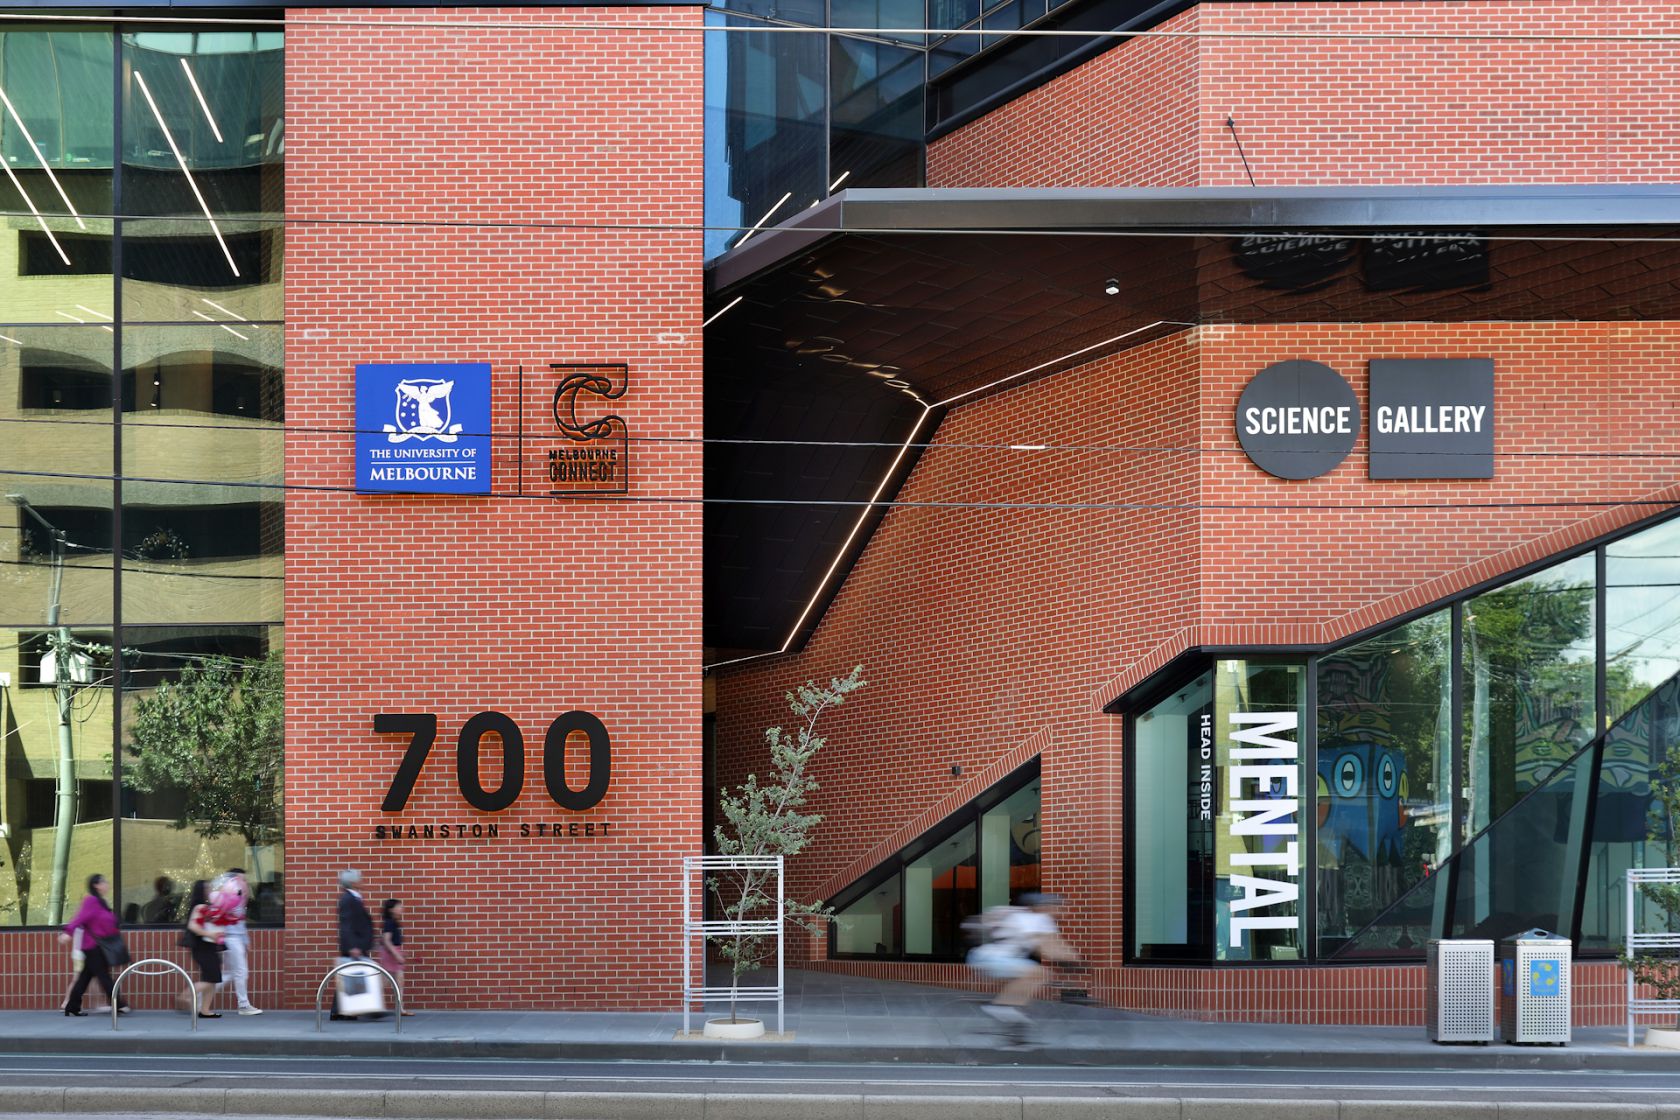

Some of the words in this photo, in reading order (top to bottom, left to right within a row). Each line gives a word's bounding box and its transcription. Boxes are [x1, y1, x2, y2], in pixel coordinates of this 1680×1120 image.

[1245, 406, 1352, 435] SCIENCE
[1377, 405, 1486, 434] GALLERY
[369, 449, 391, 459] THE
[394, 448, 459, 459] UNIVERSITY
[461, 448, 477, 459] OF
[549, 449, 617, 460] MELBOURNE
[369, 467, 477, 481] MELBOURNE
[549, 461, 617, 482] CONNECT
[1200, 714, 1211, 760] HEAD
[374, 711, 611, 811] 700
[1200, 764, 1211, 821] INSIDE
[375, 823, 499, 840] SWANSTON
[520, 822, 611, 838] STREET
[1229, 711, 1299, 948] MENTAL
